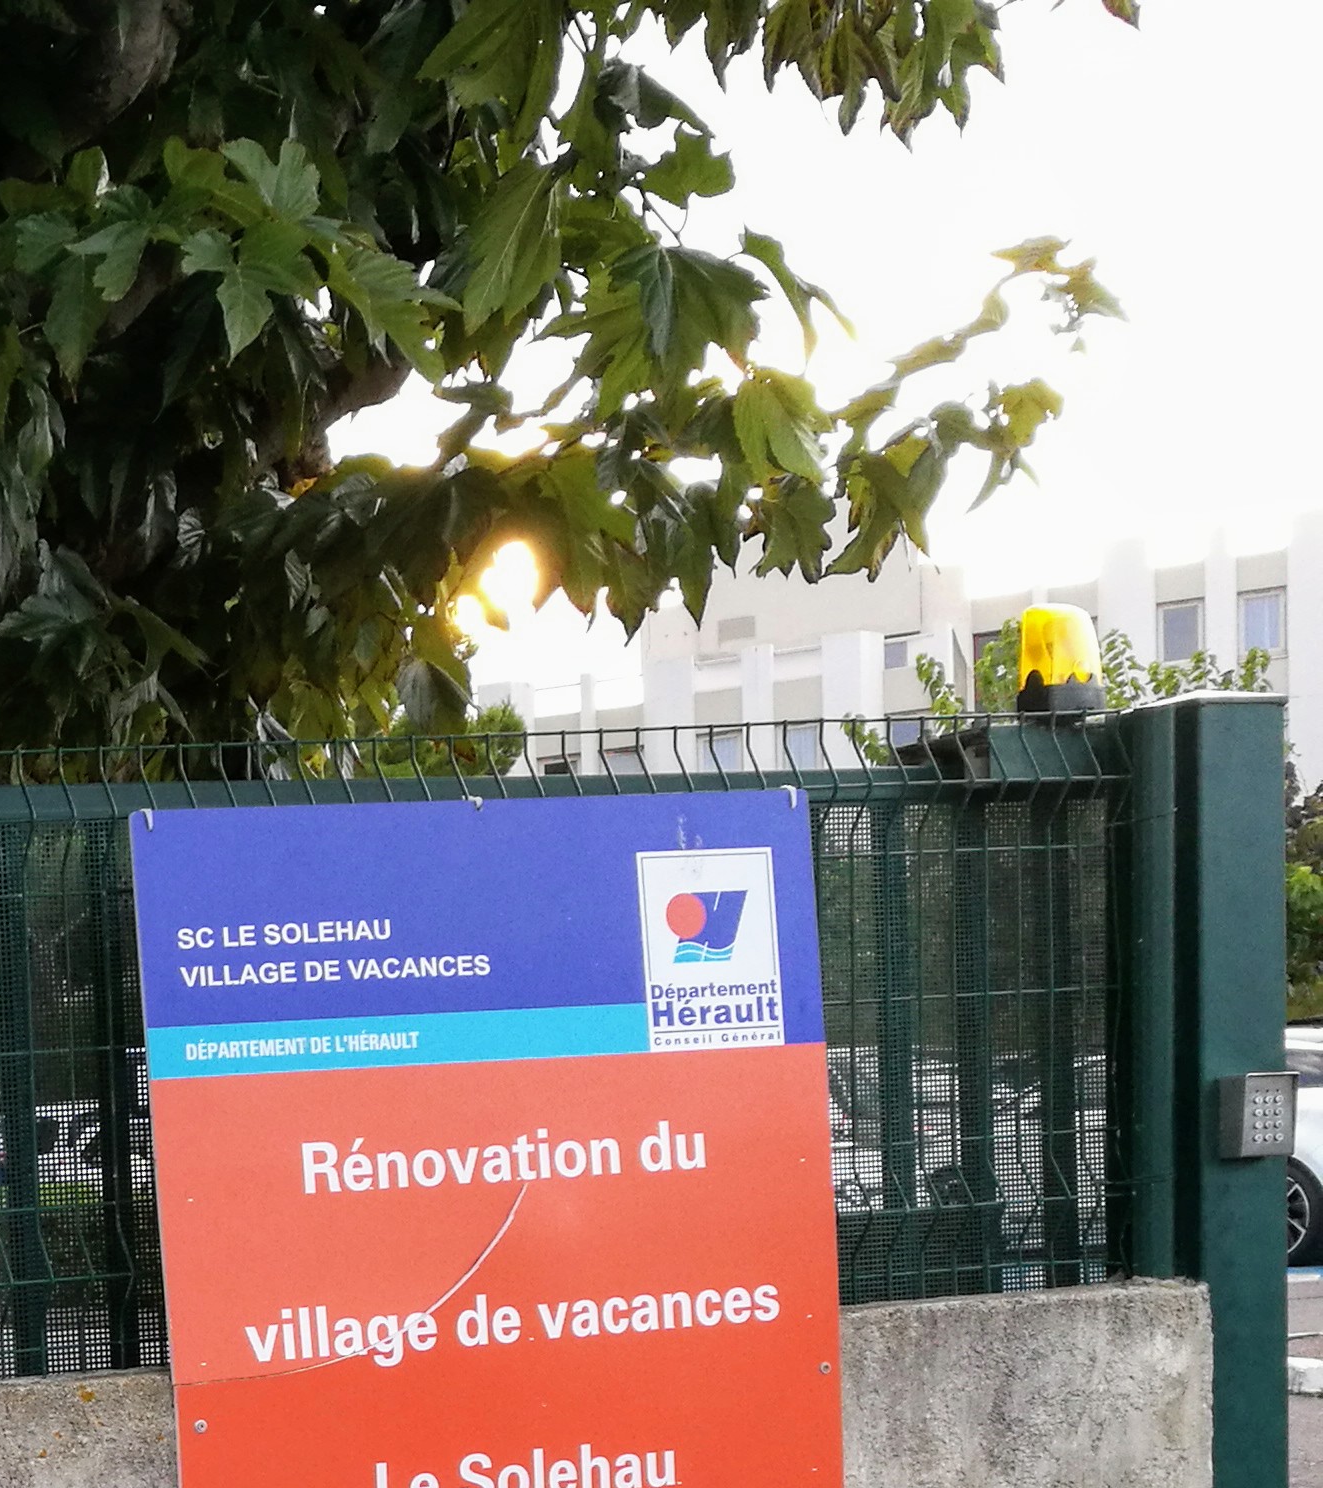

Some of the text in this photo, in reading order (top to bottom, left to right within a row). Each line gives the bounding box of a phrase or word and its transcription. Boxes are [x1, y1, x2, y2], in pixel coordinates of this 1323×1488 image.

[177, 919, 391, 949] SC LE SOLEHAU
[180, 954, 491, 987] VILLAGE DE VACANCES
[651, 979, 778, 1001] Département
[652, 996, 779, 1028] Hérault
[185, 1029, 420, 1061] DÉPARTEMENT DE L'HÉRAULT
[654, 1031, 781, 1046] Conseil Général
[301, 1120, 707, 1194] Rénovation du
[246, 1282, 780, 1367] village de vacances
